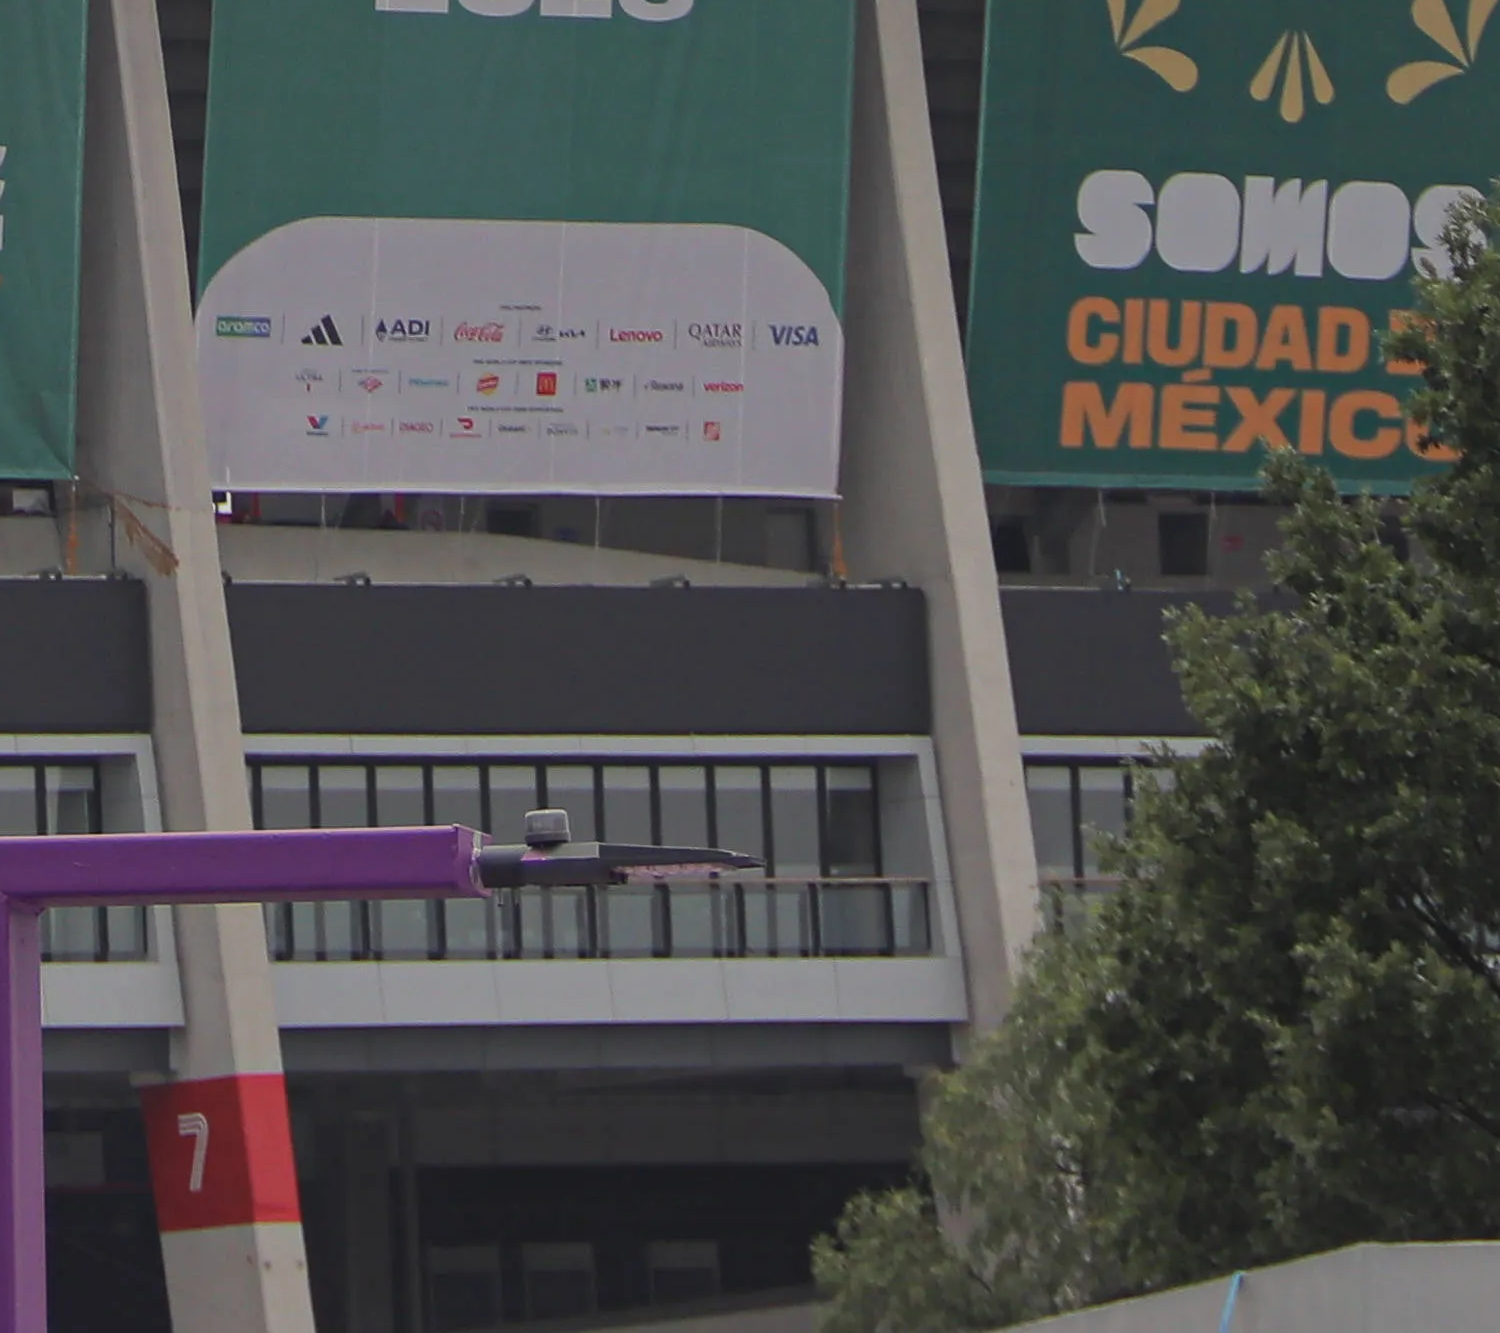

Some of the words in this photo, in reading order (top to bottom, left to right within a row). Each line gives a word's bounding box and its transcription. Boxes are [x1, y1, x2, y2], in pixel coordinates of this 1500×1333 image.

[217, 321, 271, 334] aramco
[389, 319, 430, 337] ADI
[609, 327, 664, 343] Lenovo
[688, 322, 742, 341] QATAR
[768, 324, 819, 347] VISA
[1067, 296, 1371, 373] CIUDAD
[703, 381, 745, 393] verizon
[177, 1112, 209, 1192] 7
